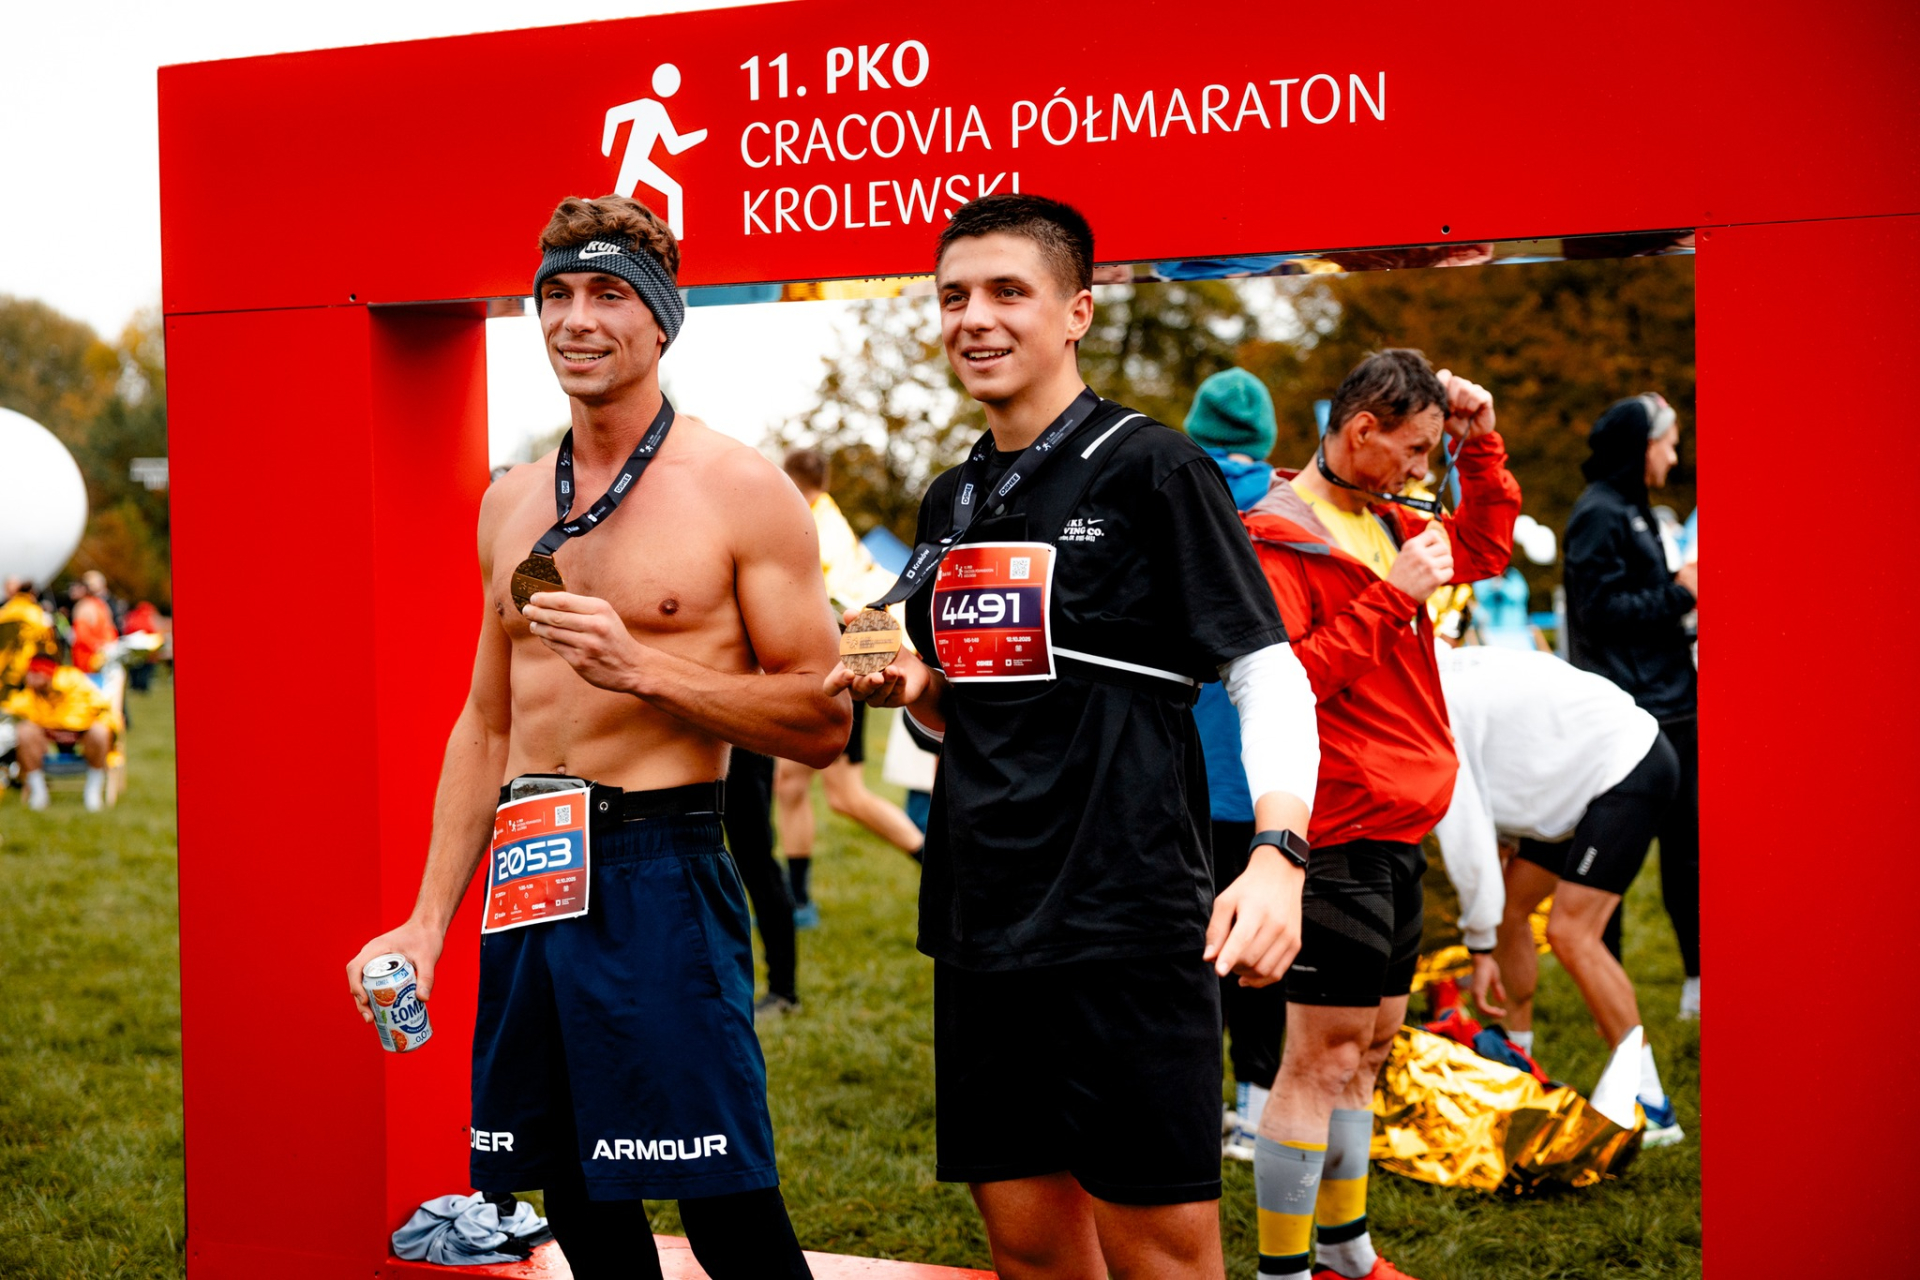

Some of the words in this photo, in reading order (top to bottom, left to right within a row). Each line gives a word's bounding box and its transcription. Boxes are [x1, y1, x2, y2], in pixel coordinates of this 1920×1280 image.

[740, 53, 807, 101] 11.
[826, 39, 930, 94] PKO
[740, 105, 991, 169] CRACOVIA
[1012, 71, 1385, 148] PÓŁMARATON
[586, 240, 621, 254] RUN
[999, 473, 1020, 496] OSHEE
[1086, 527, 1105, 537] CO.
[912, 549, 930, 571] Kraków
[941, 592, 1021, 625] 4491
[497, 837, 572, 881] 2053
[591, 1133, 728, 1161] ARMOUR
